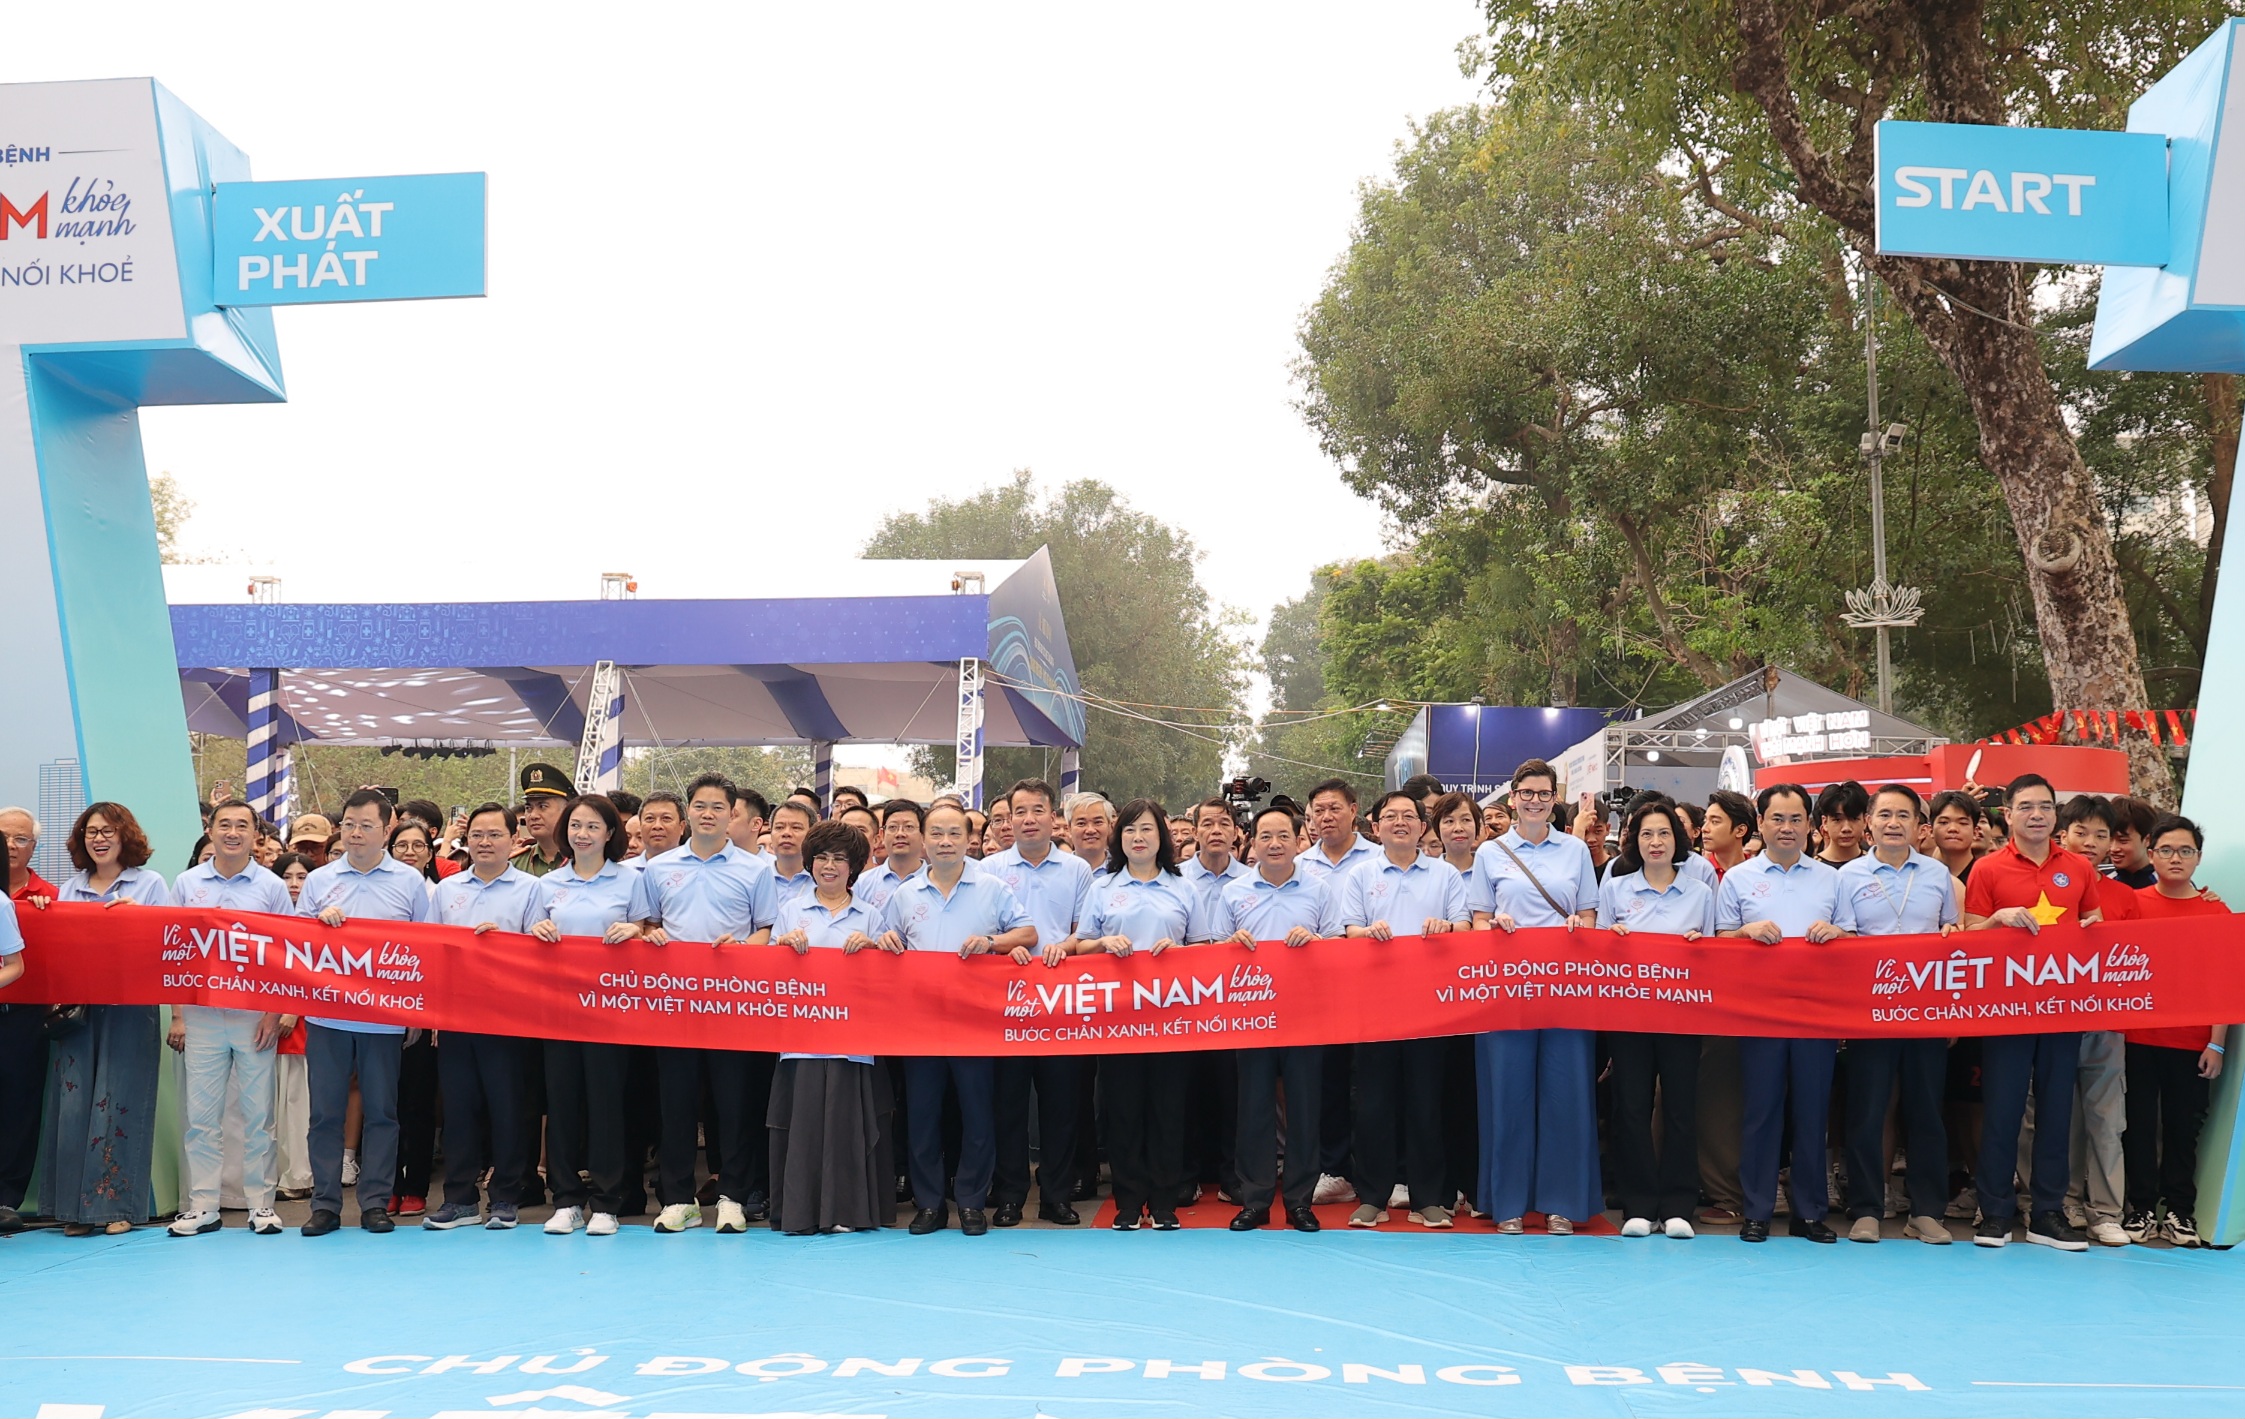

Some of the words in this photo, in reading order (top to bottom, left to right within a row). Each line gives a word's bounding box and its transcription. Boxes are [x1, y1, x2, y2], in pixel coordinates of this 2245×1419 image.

[0, 144, 50, 168] ỆNH
[60, 175, 131, 214] khỏe
[1894, 165, 2097, 217] START
[54, 201, 137, 246] mạnh
[252, 188, 395, 242] XUẤT
[1, 257, 51, 287] NỐI
[59, 254, 134, 285] KHOẺ
[237, 241, 380, 291] PHÁT
[1793, 712, 1823, 735] VIỆT
[1826, 710, 1870, 731] NAM
[163, 924, 181, 946] Vì
[162, 942, 196, 966] một
[190, 922, 273, 972] VIỆT
[284, 939, 373, 978] NAM
[378, 941, 421, 969] khỏe
[2106, 943, 2149, 968] khỏe
[377, 960, 424, 984] mạnh
[1229, 964, 1272, 988] khỏe
[1458, 959, 1498, 979] CHỦ
[1502, 959, 1559, 979] ĐỘNG
[1565, 959, 1632, 978] PHÒNG
[1637, 963, 1689, 982] BỆNH
[1875, 958, 1897, 979] Vì
[1905, 949, 1994, 1000] VIỆT
[2005, 952, 2099, 987] NAM
[2102, 960, 2153, 987] mạnh
[163, 974, 204, 988] BƯỚC
[207, 975, 255, 993] CHÂN
[259, 980, 309, 1000] XANH,
[312, 984, 341, 1002] KẾT
[344, 988, 375, 1006] NỐI
[379, 993, 424, 1011] KHOẺ
[599, 969, 638, 989] CHỦ
[642, 972, 698, 993] ĐỘNG
[703, 975, 770, 994] PHÒNG
[775, 978, 826, 999] BỆNH
[1007, 979, 1027, 1001] Vì
[1036, 972, 1121, 1022] VIỆT
[1133, 974, 1224, 1010] NAM
[1227, 980, 1277, 1007] mạnh
[1435, 985, 1454, 1003] VÌ
[1459, 983, 1501, 1003] MỘT
[1504, 980, 1545, 1001] VIỆT
[1550, 983, 1592, 998] NAM
[1598, 982, 1651, 1000] KHỎE
[1656, 987, 1713, 1005] MẠNH
[1871, 977, 1911, 1000] một
[578, 990, 596, 1008] VÌ
[601, 992, 642, 1013] MỘT
[645, 995, 685, 1016] VIỆT
[689, 999, 731, 1015] NAM
[736, 998, 788, 1018] KHỎE
[793, 1004, 849, 1023] MẠNH
[1004, 998, 1042, 1022] một
[1872, 1004, 1920, 1022] BƯỚC
[1923, 1003, 1973, 1021] CHÂN
[1977, 1002, 2032, 1018] XANH,
[2035, 995, 2066, 1015] KẾT
[2070, 994, 2102, 1013] NỐI
[2107, 992, 2154, 1011] KHOẺ
[1004, 1025, 1051, 1042] BƯỚC
[1055, 1024, 1103, 1041] CHÂN
[1107, 1022, 1159, 1039] XANH,
[1163, 1016, 1192, 1035] KẾT
[1196, 1014, 1227, 1033] NỐI
[1231, 1011, 1277, 1031] KHOẺ
[343, 1347, 610, 1375] CHỦ
[634, 1352, 1014, 1382] ĐỘNG
[1055, 1356, 1522, 1385] PHÒNG
[1562, 1361, 1933, 1393] BỆNH
